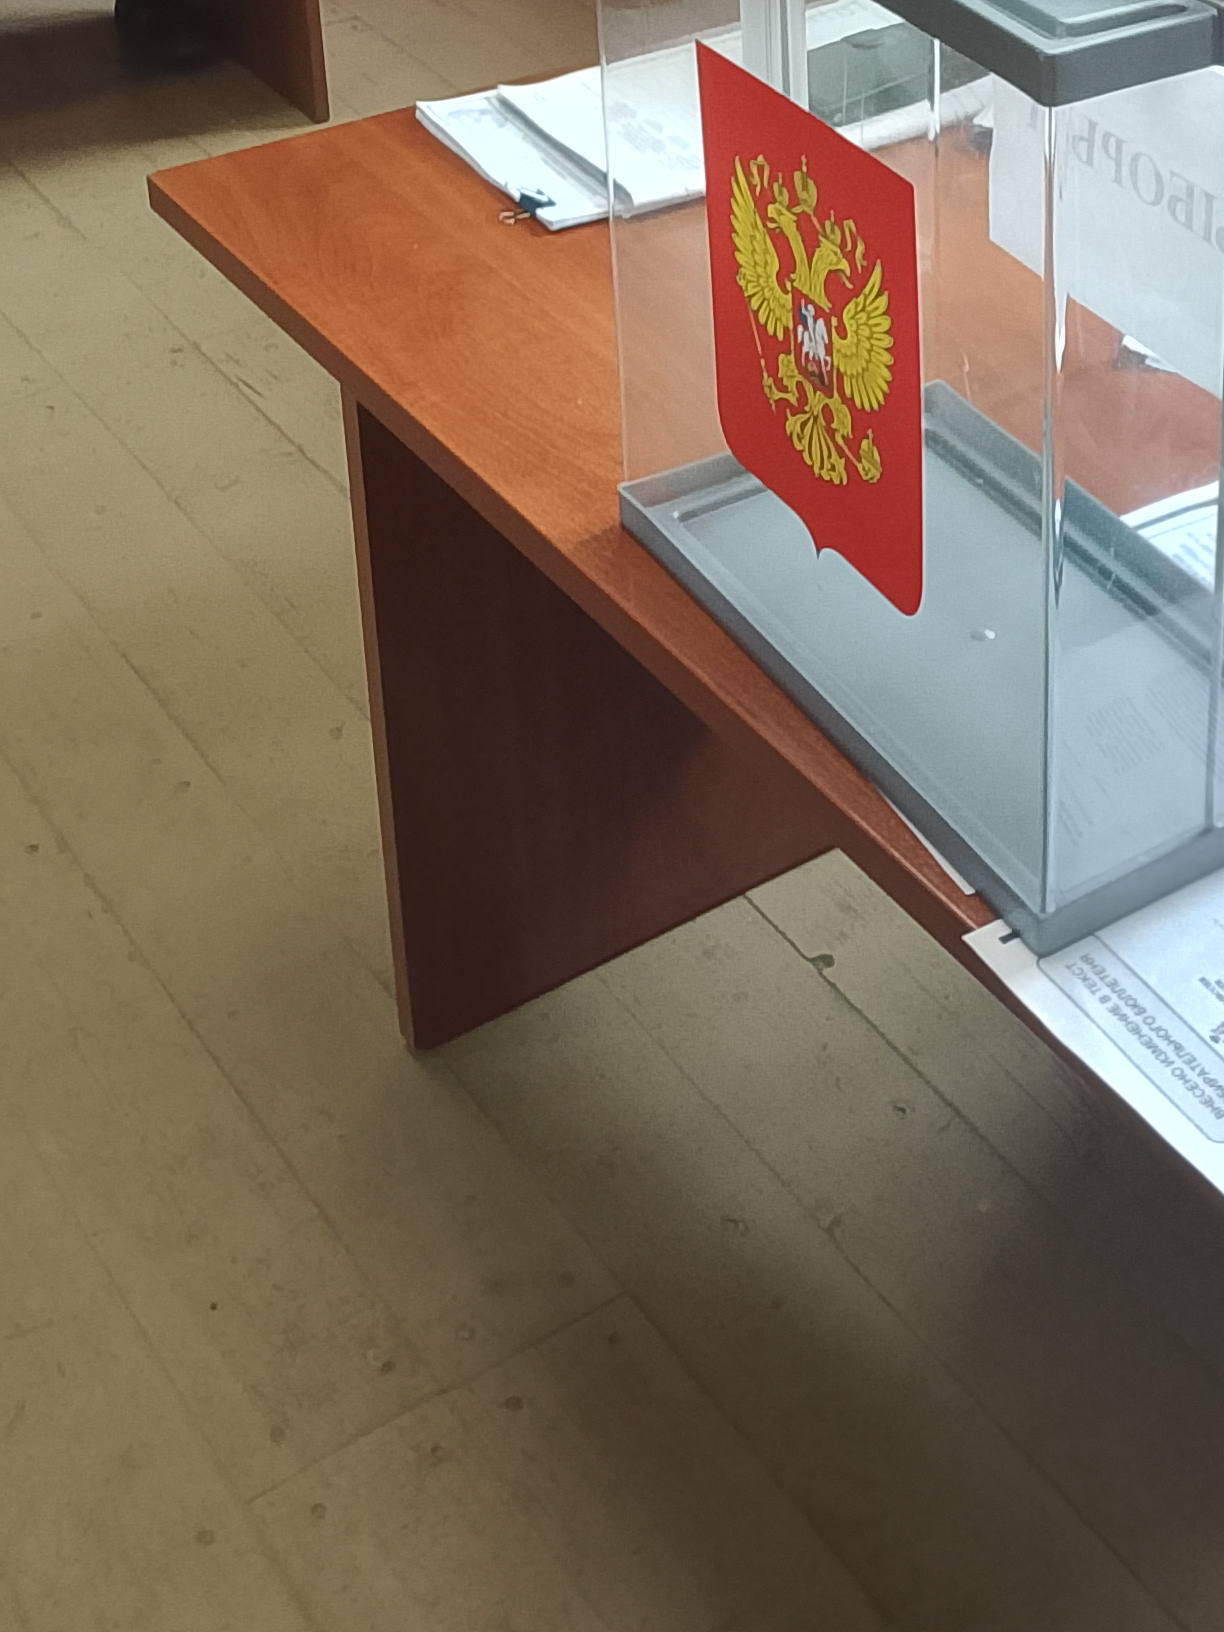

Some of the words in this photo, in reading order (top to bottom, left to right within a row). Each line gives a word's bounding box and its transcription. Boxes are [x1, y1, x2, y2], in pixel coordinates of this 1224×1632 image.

[1064, 960, 1101, 995] ТЕКСТ
[1079, 952, 1147, 1016] БЮЛЛЕТЕНЯ
[1097, 994, 1112, 1004] В
[1106, 1002, 1175, 1067] ИЗМЕНЕНИЕ
